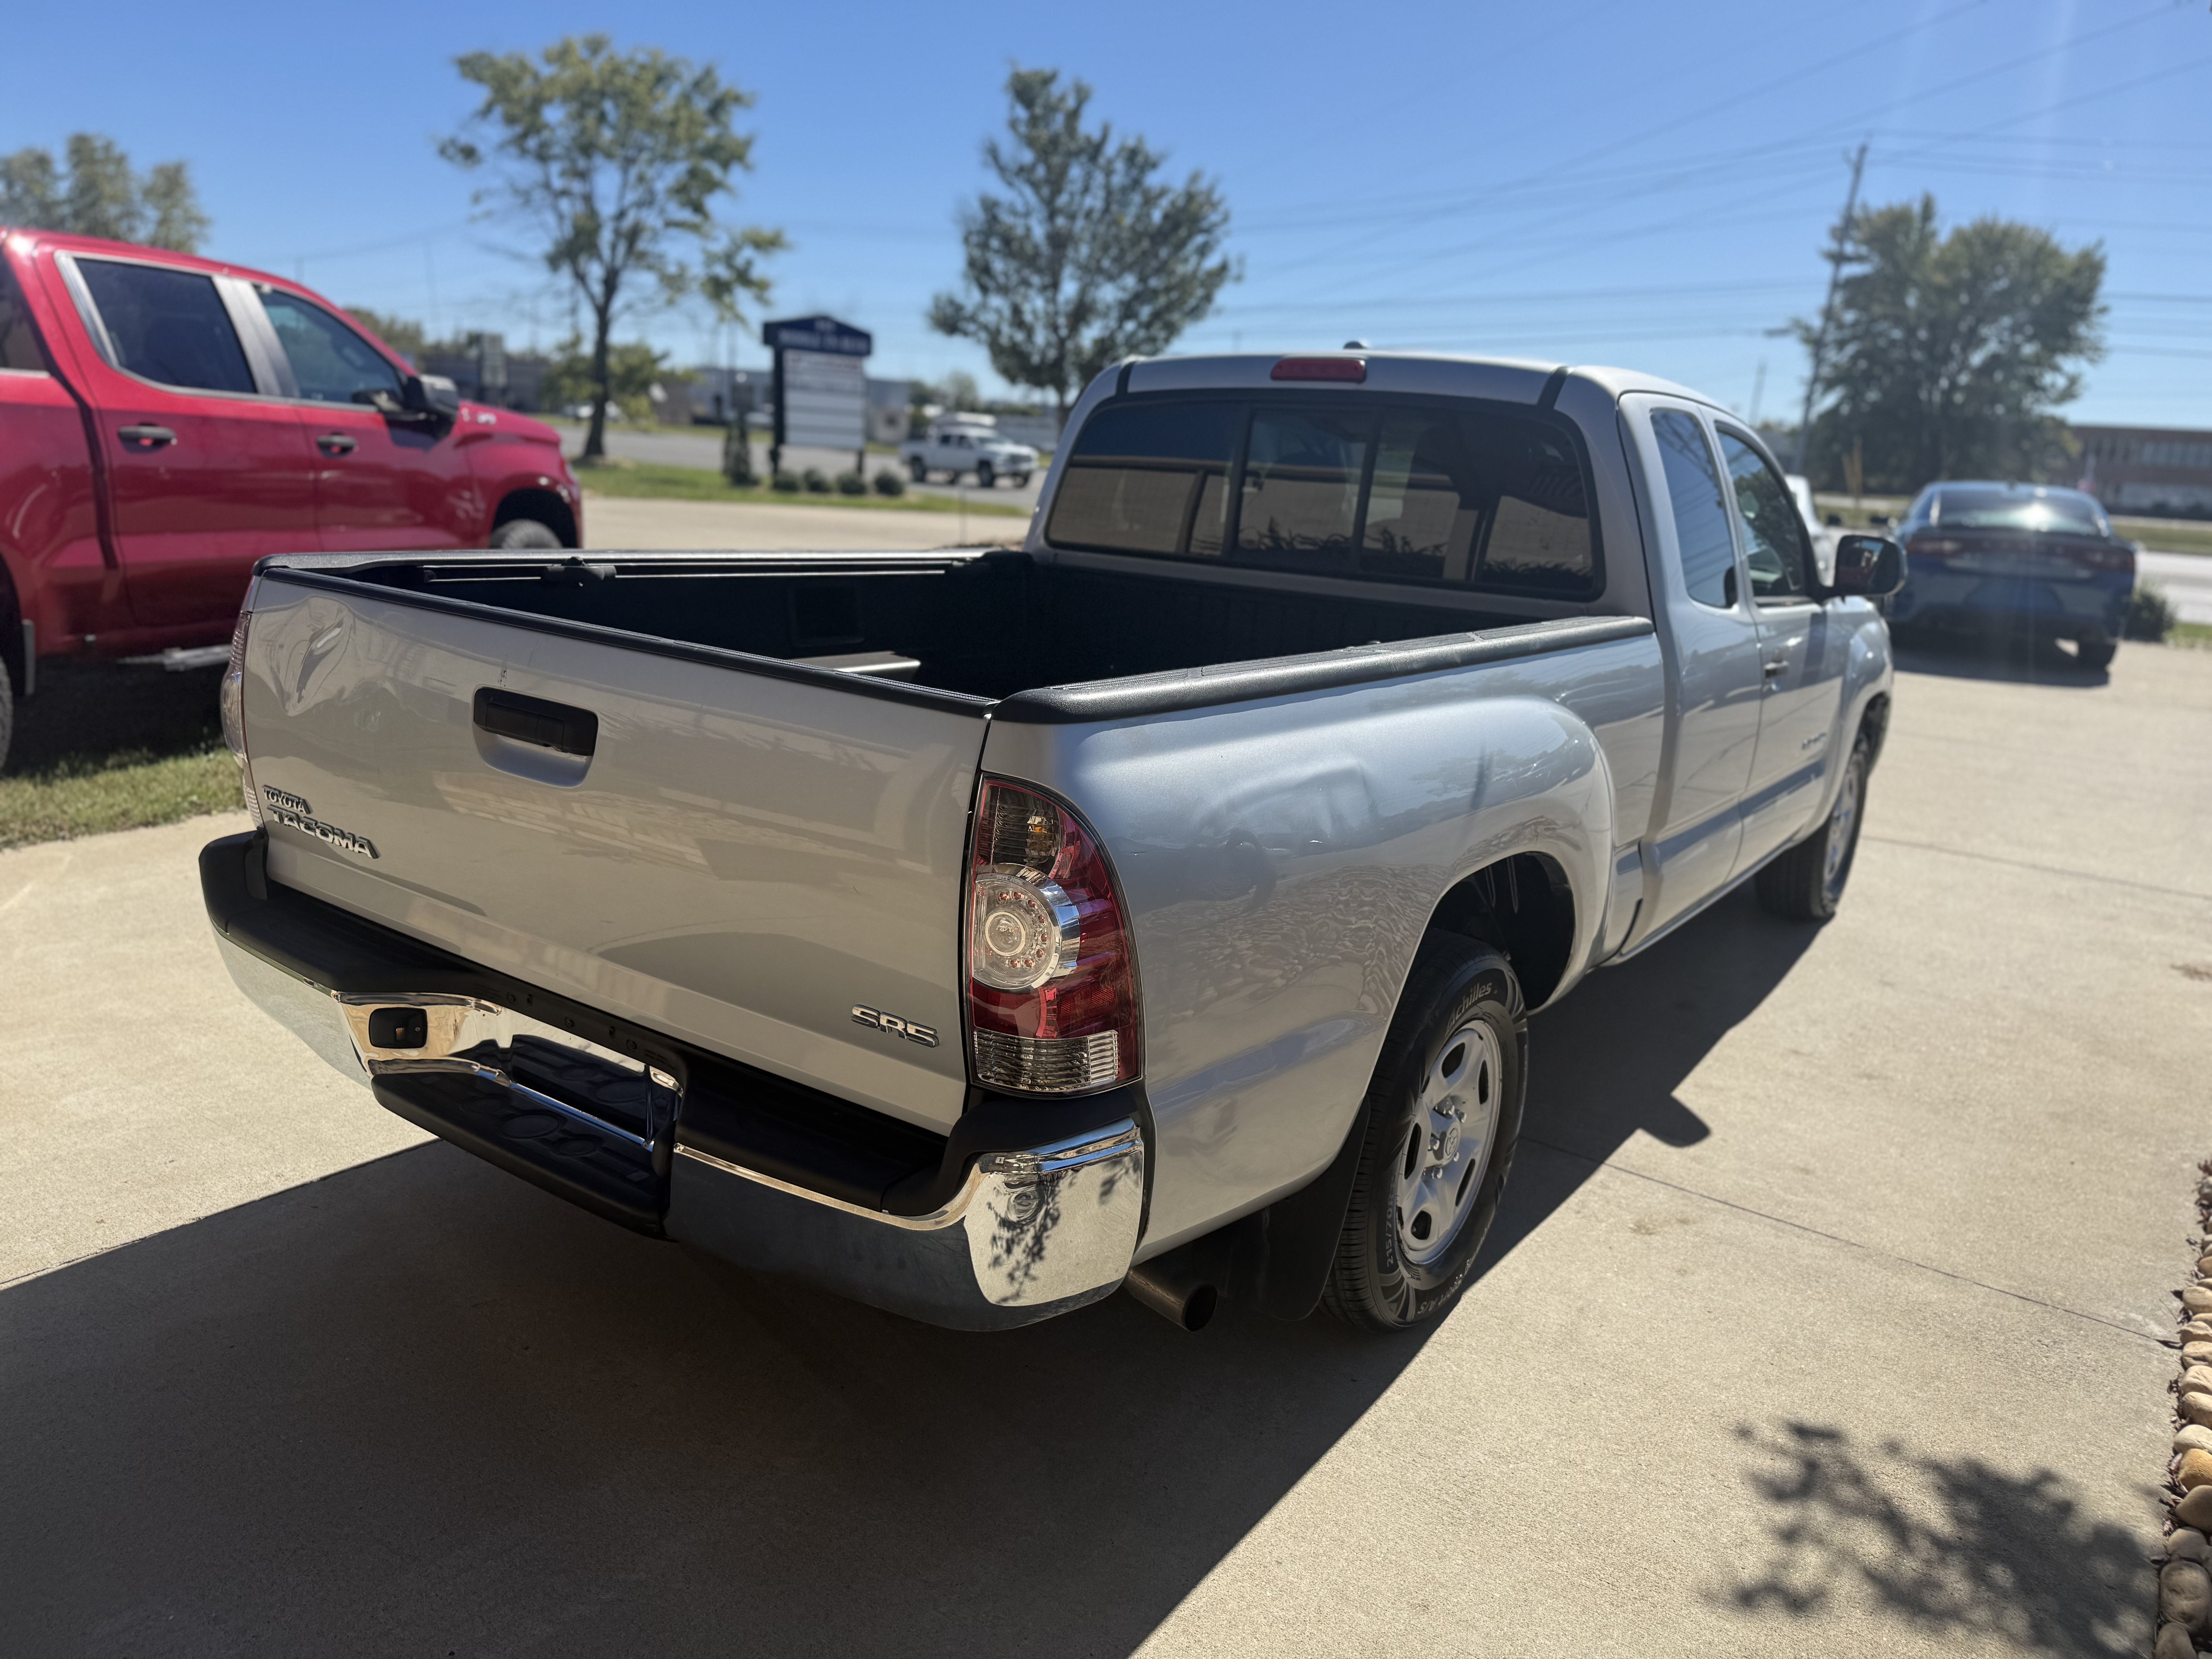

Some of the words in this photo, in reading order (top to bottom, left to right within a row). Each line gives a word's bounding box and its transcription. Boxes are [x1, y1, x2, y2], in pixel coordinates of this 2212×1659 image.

[262, 785, 311, 814] TOYOTA
[267, 804, 380, 859] TACOMA
[850, 1004, 939, 1048] SR5
[1445, 982, 1492, 1037] Achilles
[1417, 1297, 1438, 1314] A/S
